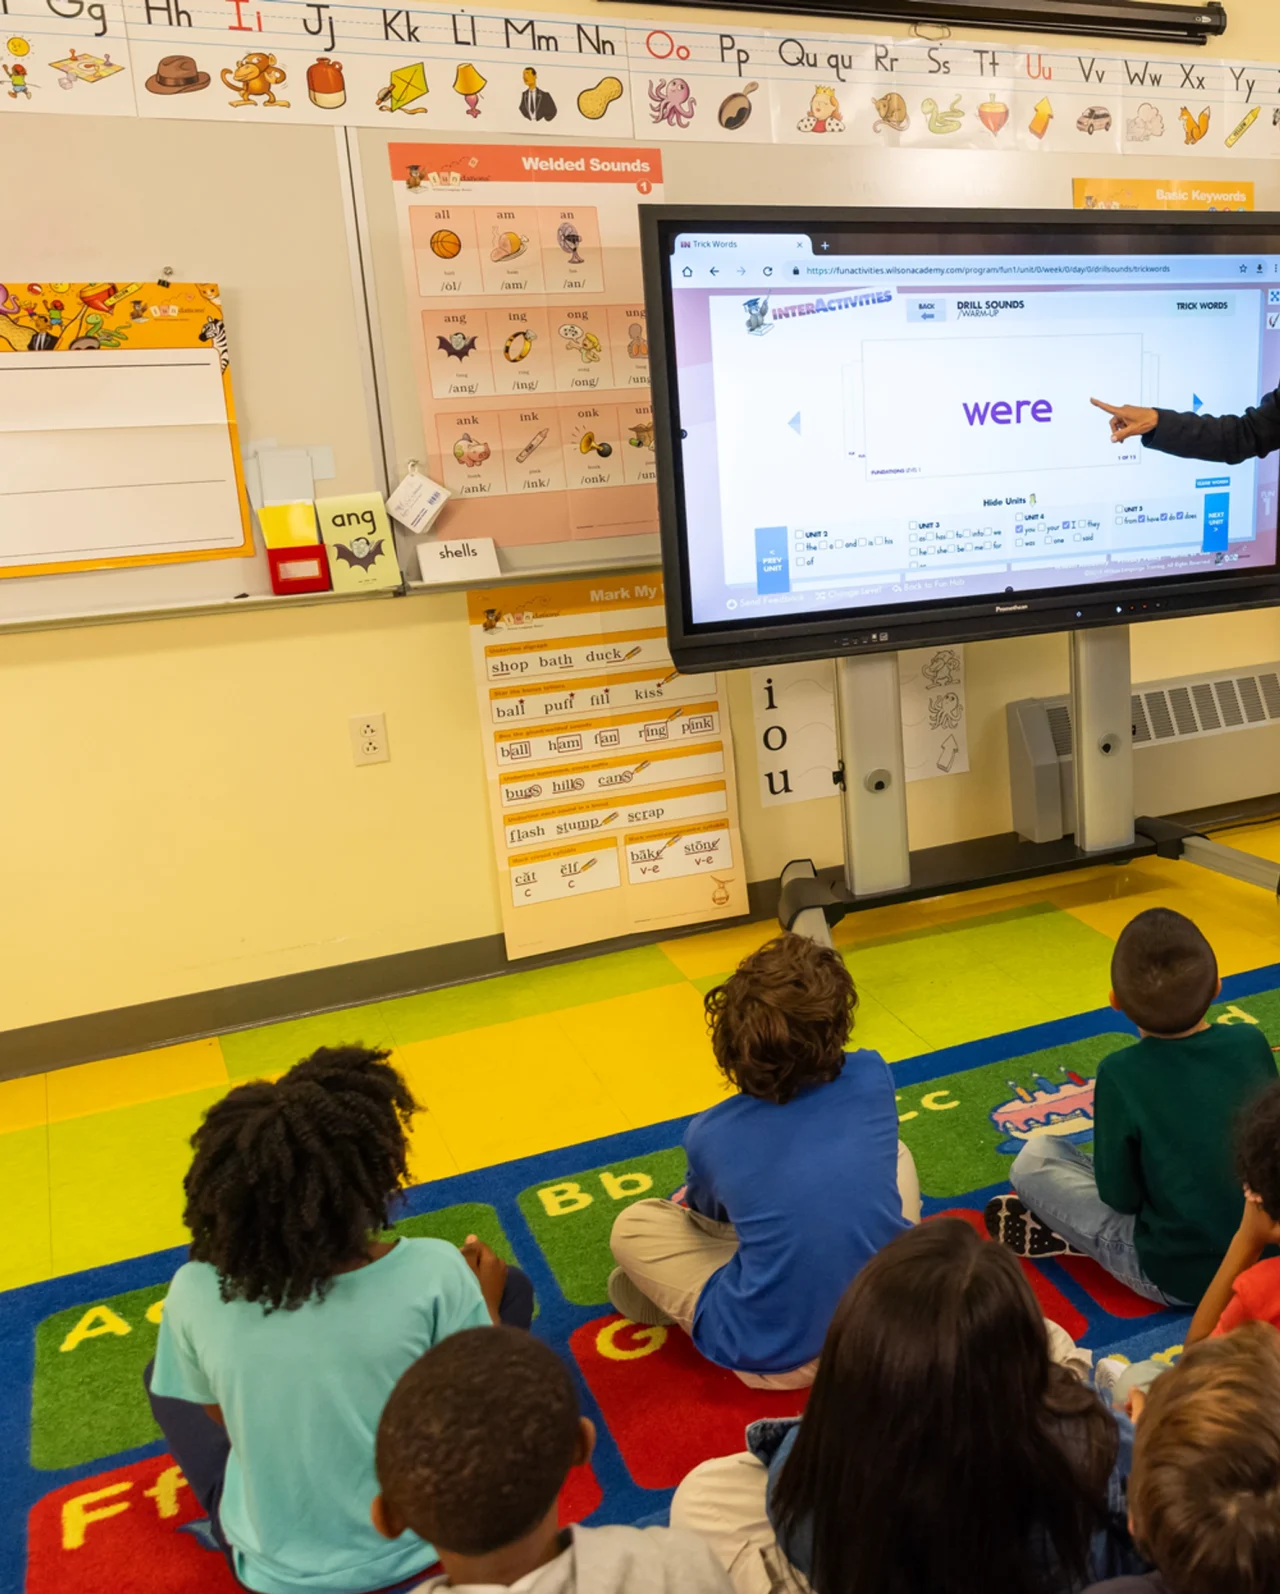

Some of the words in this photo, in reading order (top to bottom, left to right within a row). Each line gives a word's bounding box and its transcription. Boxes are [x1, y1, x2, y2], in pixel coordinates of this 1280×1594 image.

[226, 0, 264, 32] Ii
[303, 3, 336, 52] Jj
[383, 9, 421, 44] Kk
[453, 10, 478, 46] Ll
[504, 17, 558, 53] Mm
[577, 24, 616, 56] Nn
[646, 30, 690, 62] Oo
[720, 35, 750, 78] Pp
[778, 38, 818, 70] Qu
[828, 48, 853, 84] qu
[874, 44, 898, 73] Rr
[927, 45, 951, 76] Ss
[973, 49, 999, 77] Tt
[1026, 53, 1053, 82] Uu
[1078, 57, 1105, 84] Vv
[1124, 61, 1163, 89] Ww
[1180, 64, 1206, 91] Xx
[1230, 67, 1256, 104] Yy
[522, 156, 585, 172] Welded
[589, 158, 651, 173] Sounds
[639, 180, 650, 194] 1
[1156, 189, 1188, 201] Basic
[1191, 190, 1246, 204] Keywords
[434, 209, 450, 220] all
[496, 211, 516, 220] am
[560, 211, 575, 220] an
[693, 240, 711, 248] Trick
[712, 240, 738, 248] Words
[500, 280, 528, 291] /am/
[563, 279, 586, 290] /an/
[957, 301, 983, 310] DRILL
[985, 300, 1025, 309] SOUNDS
[1176, 302, 1198, 310] TRICK
[1199, 301, 1228, 310] WORDS
[444, 313, 467, 325] ang
[508, 311, 528, 323] ing
[567, 309, 589, 321] ong
[448, 383, 479, 394] /ang/
[512, 380, 539, 391] /ing/
[571, 377, 600, 388] /ong/
[456, 415, 480, 425] ank
[519, 411, 540, 422] ink
[577, 408, 600, 418] onk
[962, 398, 1053, 427] were
[460, 483, 492, 495] /ank/
[522, 478, 551, 490] /ink/
[580, 474, 611, 485] /onk/
[983, 497, 1003, 507] Hide
[1005, 496, 1026, 506] Units
[332, 508, 374, 535] ang
[1024, 513, 1039, 521] UNIT
[1208, 511, 1224, 519] NEXT
[1208, 518, 1224, 526] UNIT
[1025, 526, 1036, 535] you
[1087, 519, 1100, 530] they
[438, 543, 478, 559] shells
[806, 543, 818, 551] the
[845, 539, 858, 548] and
[884, 536, 893, 544] his
[762, 556, 783, 565] PREV
[763, 564, 782, 572] UNIT
[806, 556, 814, 566] of
[589, 588, 630, 602] Mark
[634, 586, 657, 600] My
[491, 660, 529, 674] shop
[539, 653, 573, 668] bath
[586, 648, 622, 663] duck
[496, 704, 525, 718] ball
[544, 697, 574, 715] puff
[590, 694, 610, 706] fill
[635, 687, 663, 700] kiss
[764, 678, 778, 711] i
[500, 745, 529, 758] ball
[548, 737, 580, 751] ham
[594, 731, 617, 745] fan
[639, 725, 666, 739] ring
[682, 718, 711, 734] pink
[762, 724, 787, 752] o
[506, 785, 541, 799] bugs
[552, 779, 583, 792] hills
[598, 771, 632, 785] cans
[765, 769, 793, 796] u
[510, 826, 546, 843] flash
[556, 816, 600, 834] stump
[628, 807, 664, 822] scrap
[640, 864, 660, 875] v-e
[694, 854, 714, 865] v-e
[536, 1169, 654, 1218] Bb
